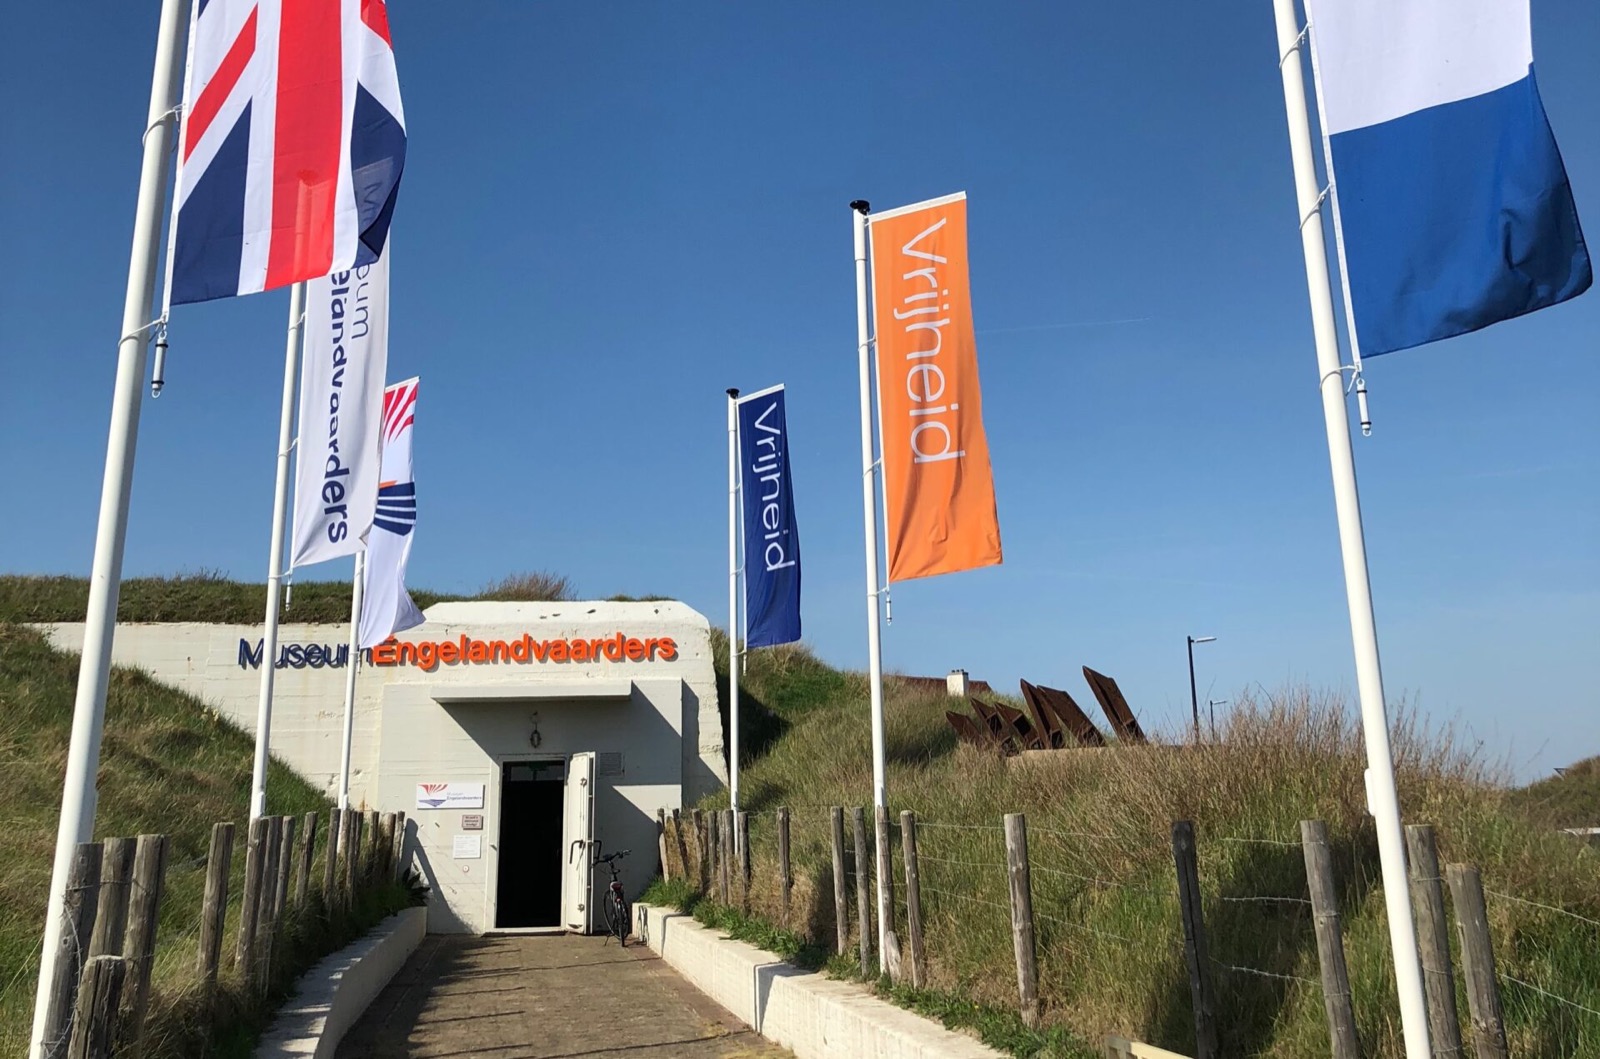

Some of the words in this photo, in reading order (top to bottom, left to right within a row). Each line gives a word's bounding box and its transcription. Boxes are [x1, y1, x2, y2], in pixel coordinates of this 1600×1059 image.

[321, 269, 350, 544] elandvaarders
[893, 217, 966, 464] Vrijheid
[752, 402, 796, 572] Vrijheid
[372, 631, 677, 671] Engelandvaarders
